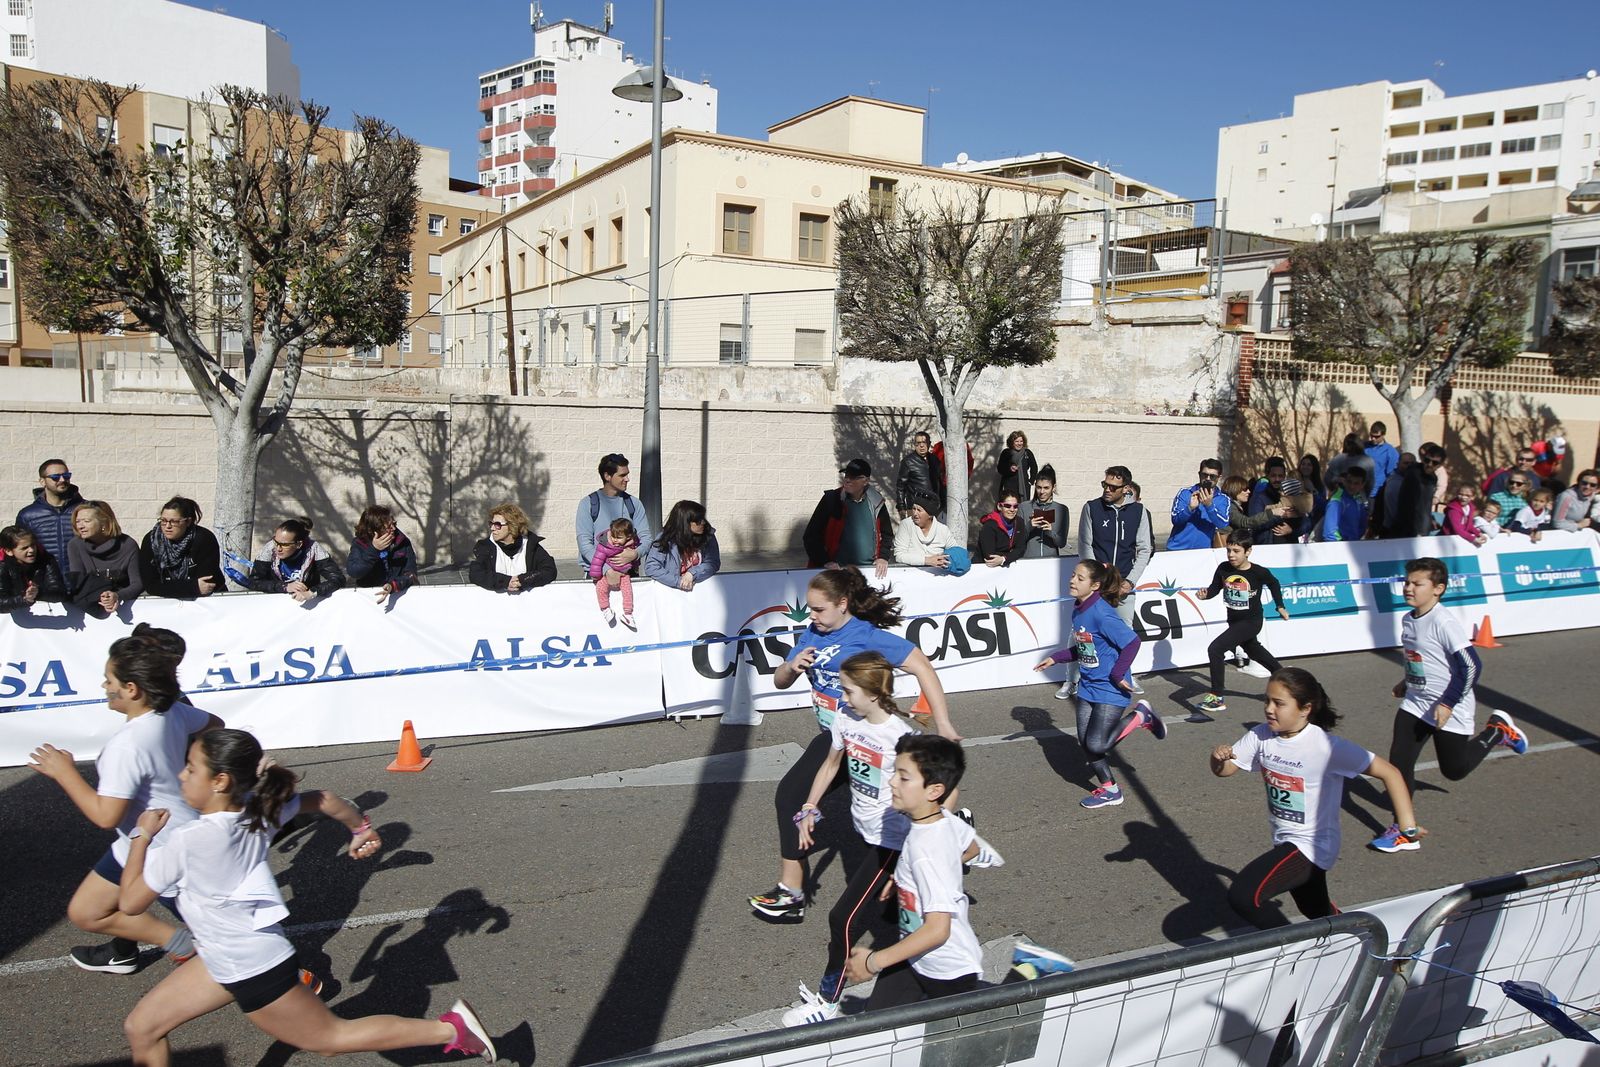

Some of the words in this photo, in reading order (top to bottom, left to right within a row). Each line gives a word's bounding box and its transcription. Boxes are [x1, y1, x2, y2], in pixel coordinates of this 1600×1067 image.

[464, 634, 612, 672] ALSA
[905, 611, 1011, 663] CASI
[0, 659, 78, 699] SA
[196, 644, 356, 689] ALSA
[850, 758, 871, 778] 32
[1268, 785, 1291, 804] 02
